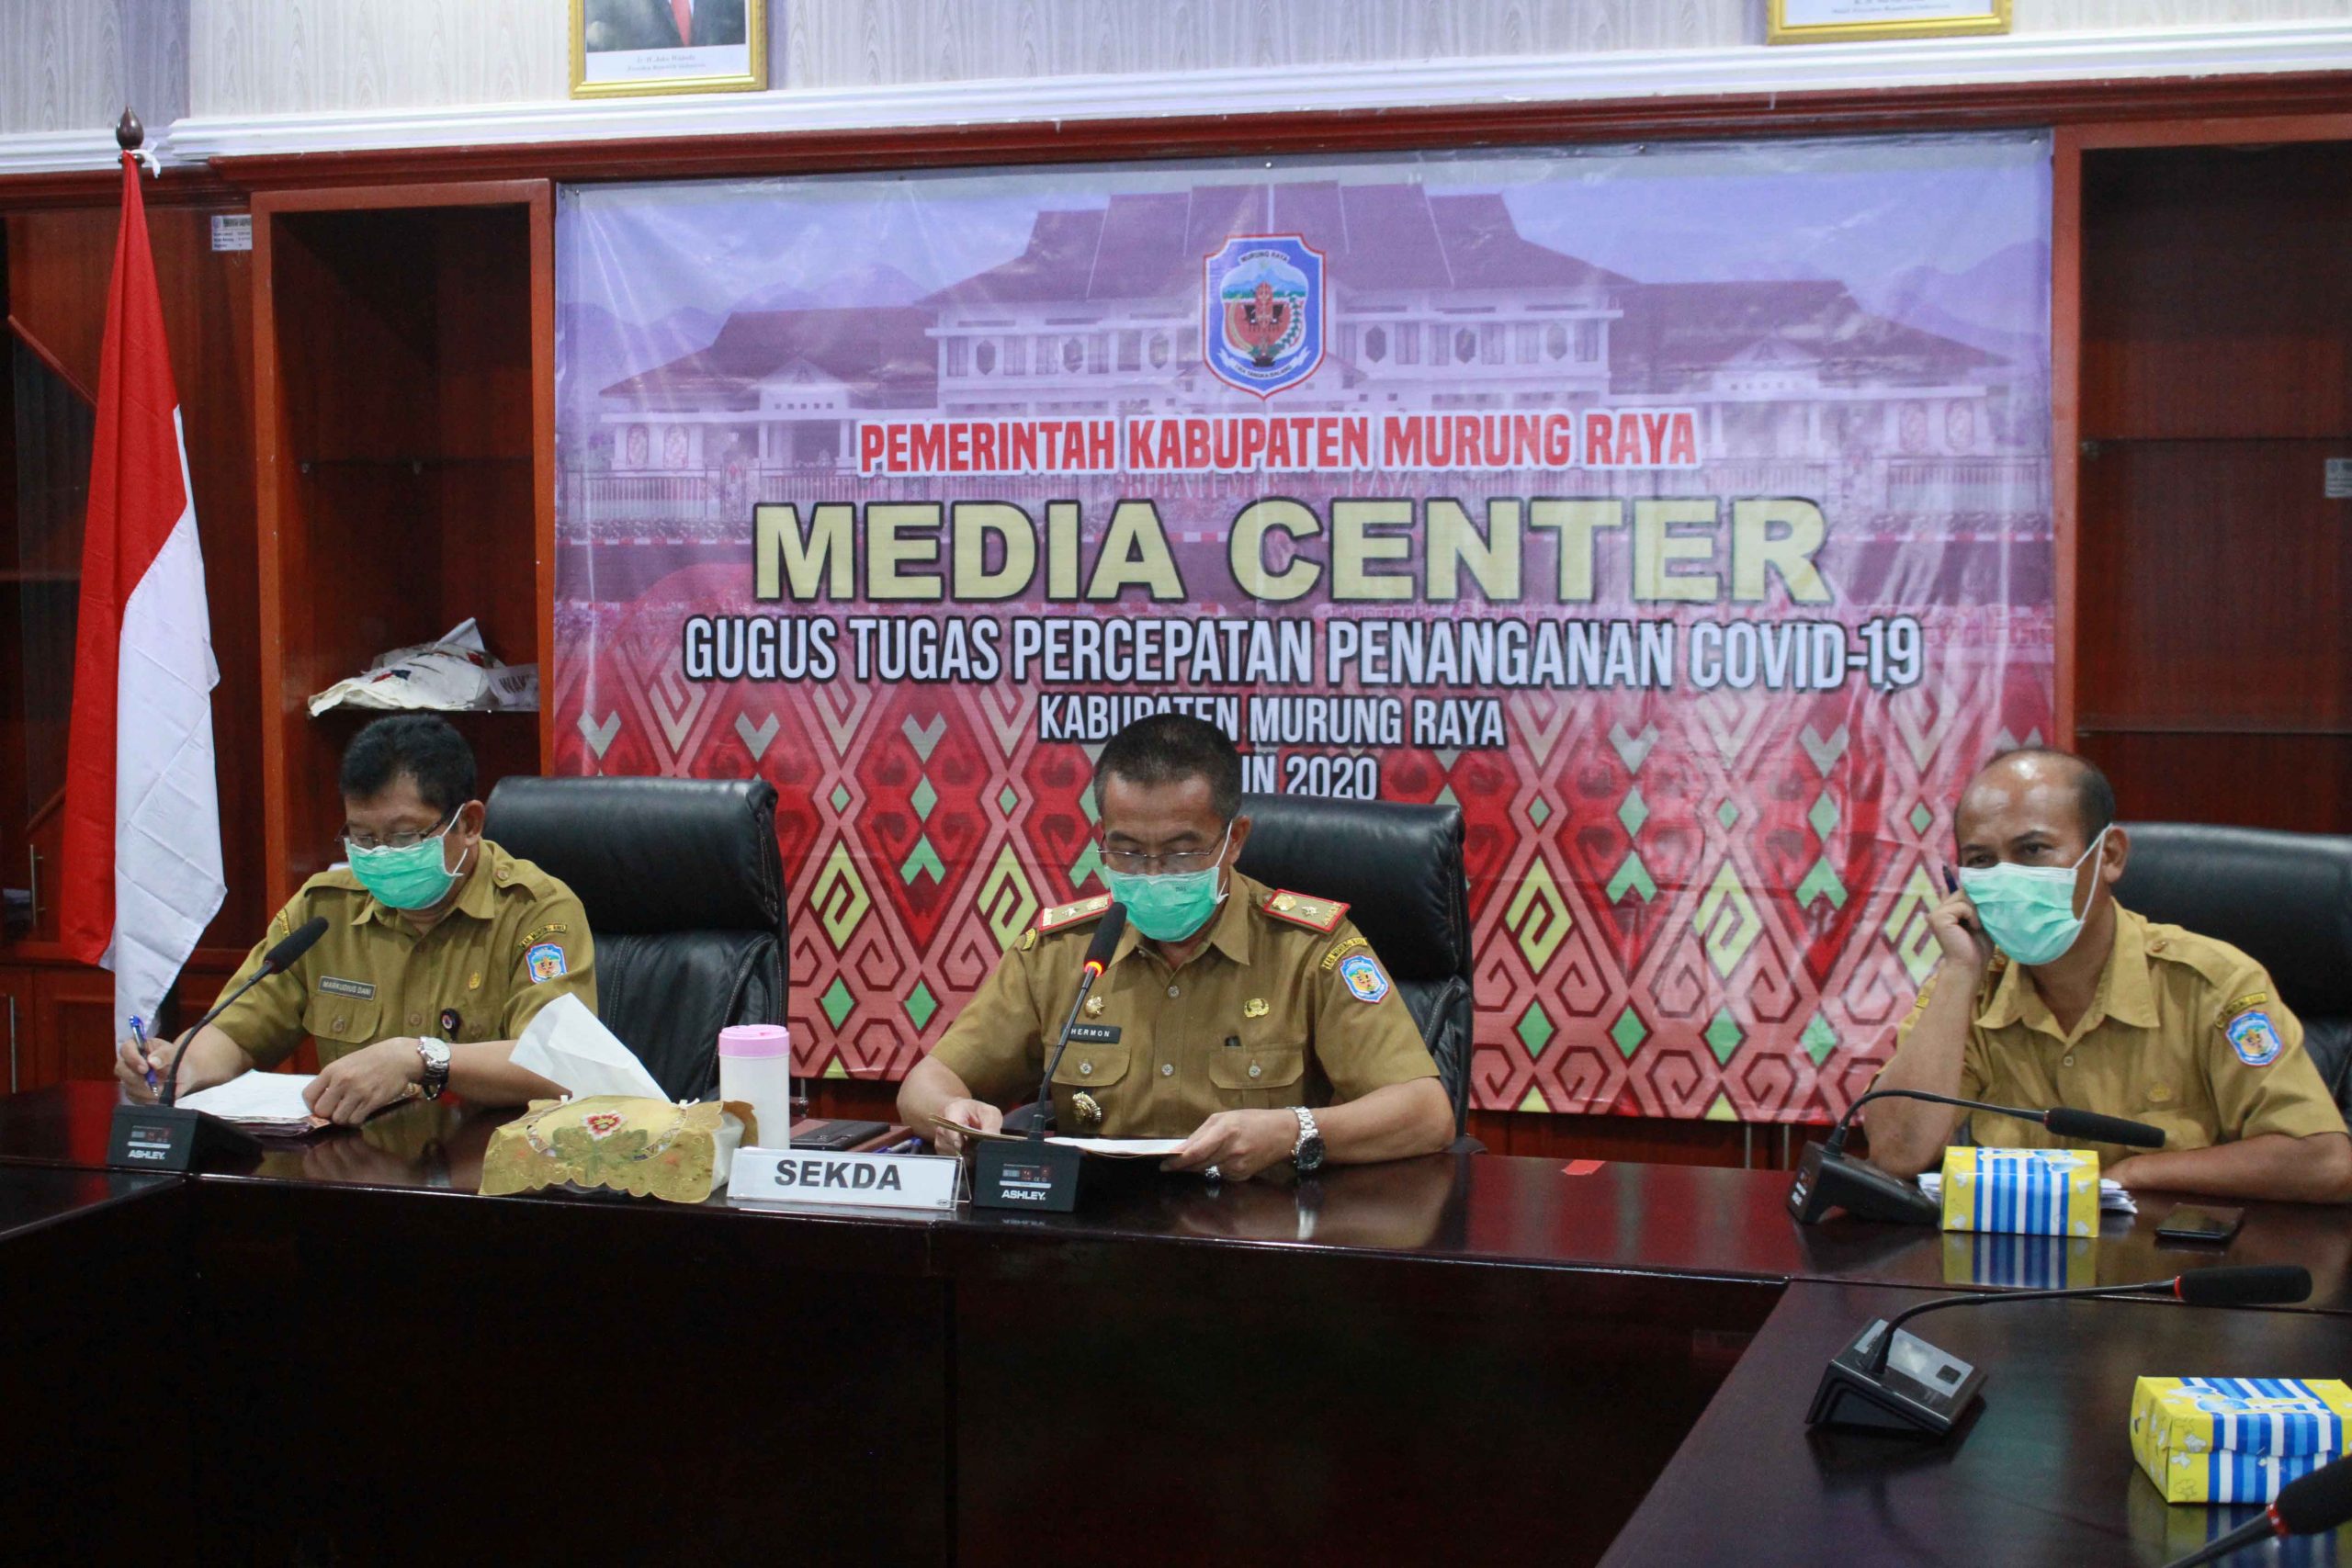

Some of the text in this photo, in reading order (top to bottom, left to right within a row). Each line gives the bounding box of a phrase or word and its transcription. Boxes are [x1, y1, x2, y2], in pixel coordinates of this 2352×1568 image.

[860, 412, 1697, 473] PEMERINTAH KABUPATEN MURUNG RAYA
[752, 496, 1833, 604] MEDIA CENTER
[684, 616, 1923, 691] GUGUS TUGAS PERCEPATAN PENANGANAN COVID-19
[1249, 696, 1403, 746] MURUNG
[1413, 699, 1506, 747] RAYA
[1285, 756, 1378, 801] 2020
[1070, 1028, 1111, 1037] HERMON
[129, 1149, 165, 1160] ASHLEY
[775, 1159, 901, 1190] SEKDA
[1001, 1189, 1046, 1201] ASHLEY
